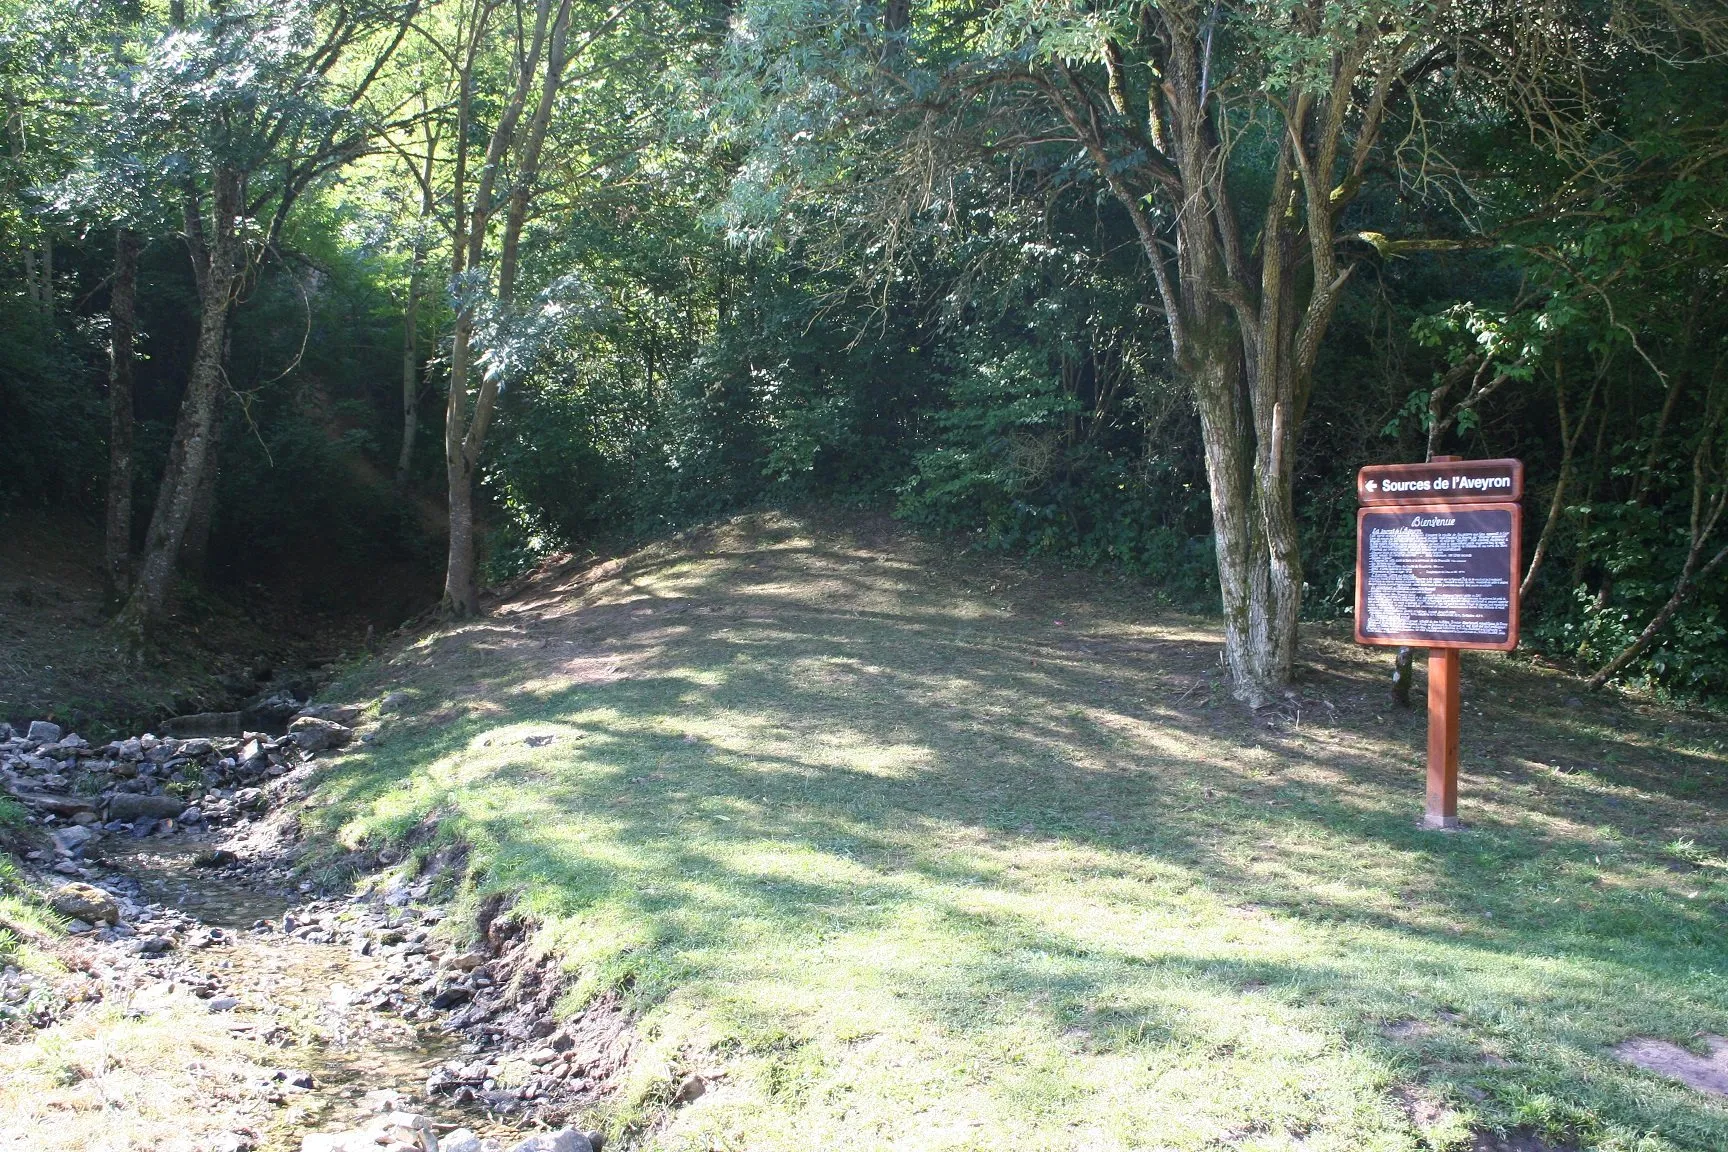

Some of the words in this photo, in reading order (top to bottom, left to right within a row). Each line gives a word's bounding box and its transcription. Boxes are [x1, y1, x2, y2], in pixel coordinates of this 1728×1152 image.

[1382, 479, 1431, 492] Sources
[1433, 477, 1449, 490] de
[1452, 476, 1511, 491] l'Aveyron
[1411, 516, 1456, 528] Bienvenue
